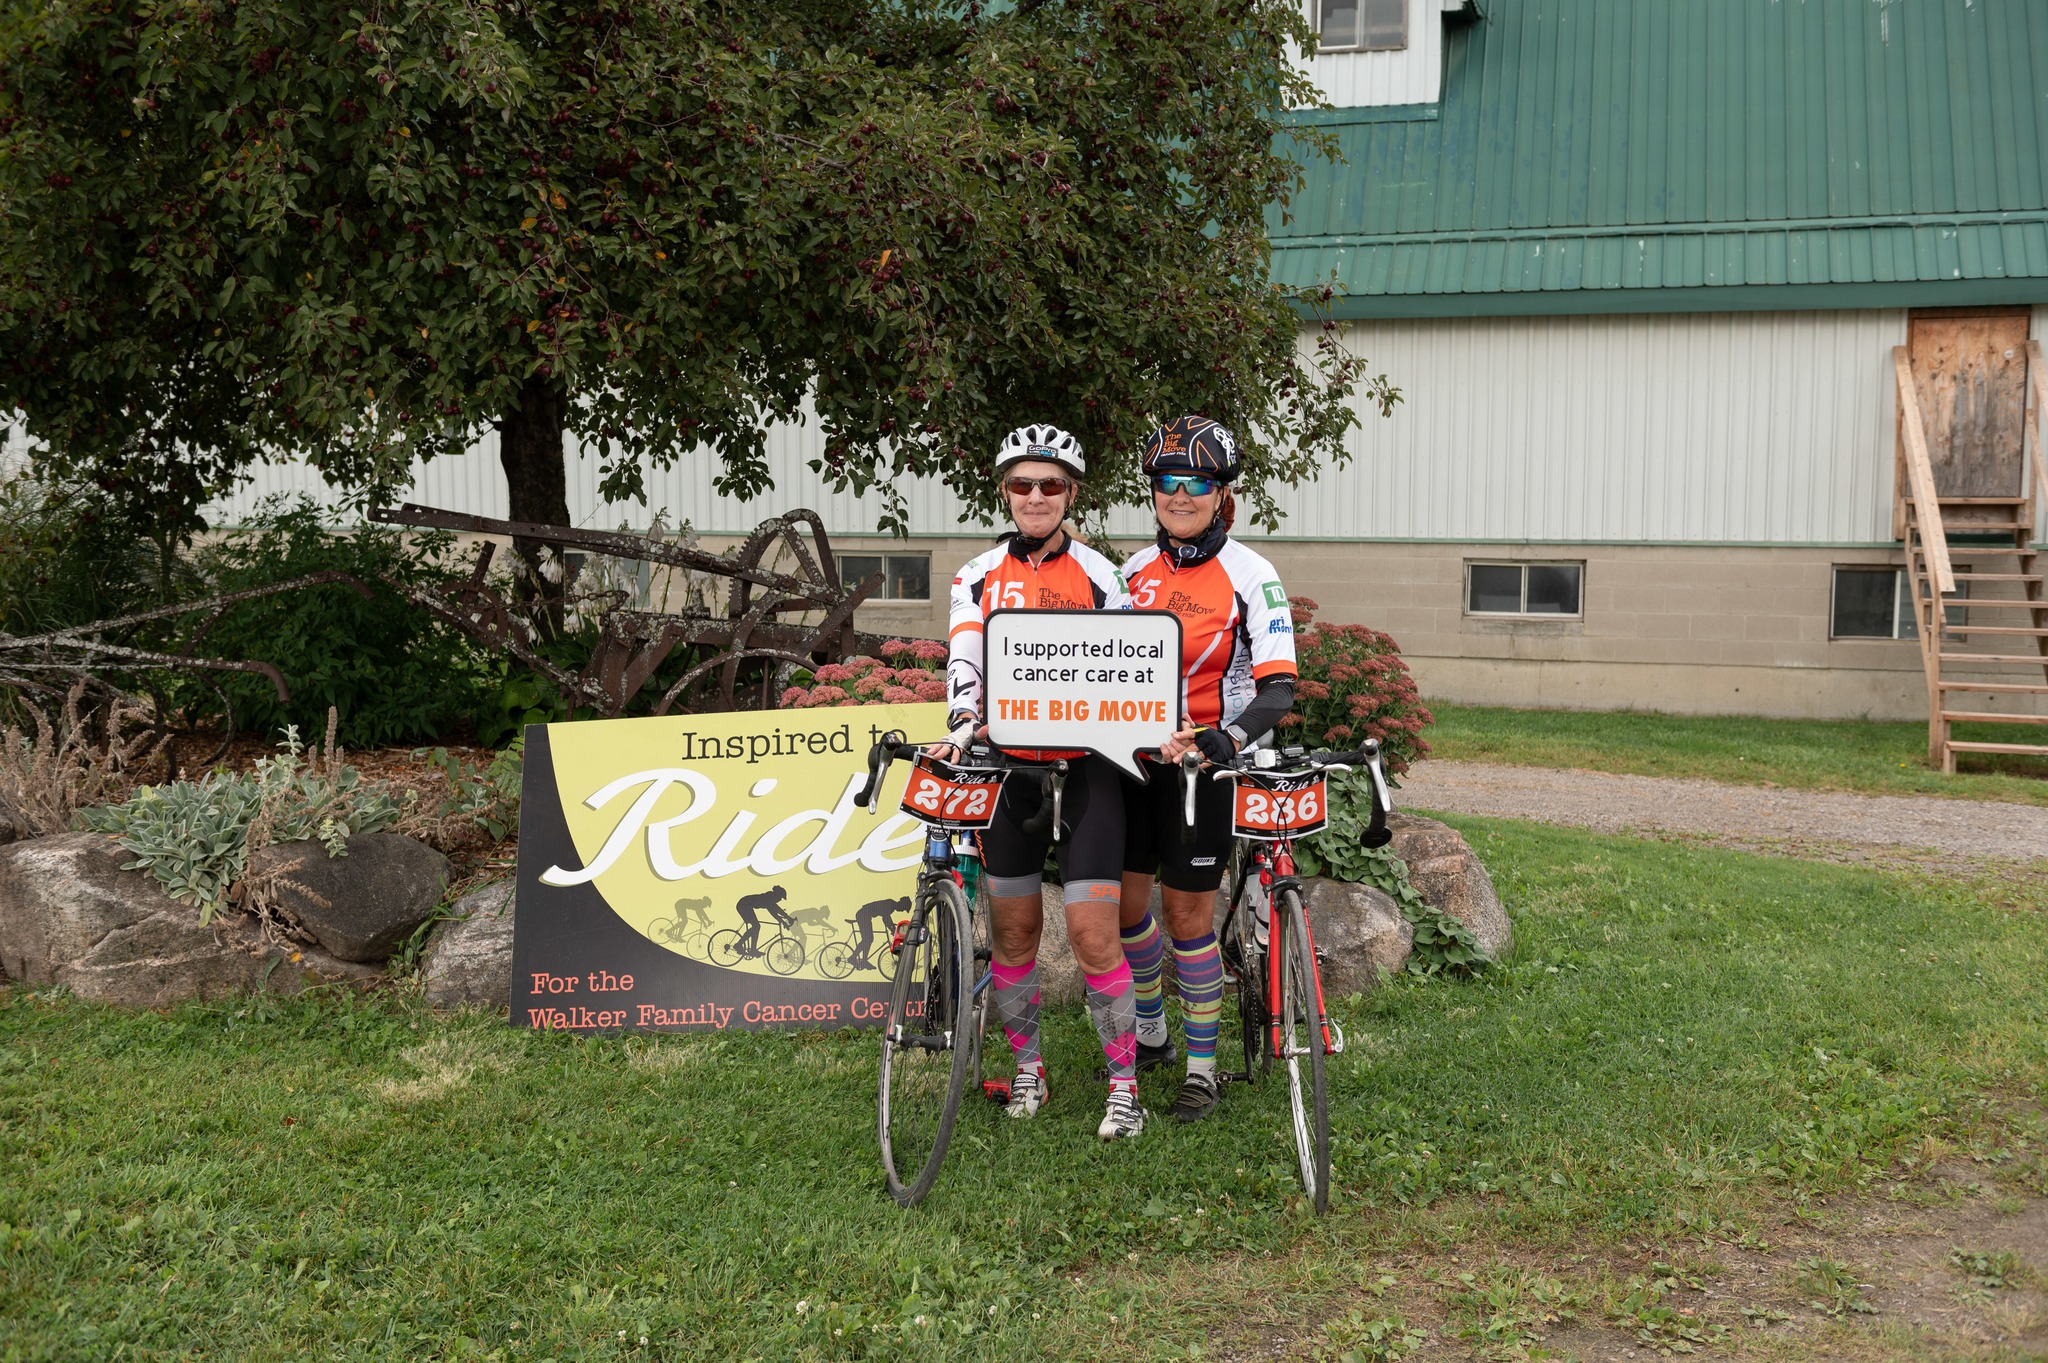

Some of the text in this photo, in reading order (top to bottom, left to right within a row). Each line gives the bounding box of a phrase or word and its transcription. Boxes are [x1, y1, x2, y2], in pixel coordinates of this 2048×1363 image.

[1028, 445, 1057, 454] GoPro
[986, 580, 1025, 609] 15
[1039, 587, 1061, 600] The
[1039, 597, 1058, 609] Big
[1165, 599, 1186, 612] Big
[1170, 591, 1191, 602] The
[1265, 586, 1286, 602] TD
[1004, 637, 1163, 661] I supported local
[1013, 667, 1154, 684] cancer care at
[998, 699, 1167, 723] THE BIG MOVE
[682, 724, 854, 764] Inspired
[949, 772, 986, 784] Ride
[914, 778, 989, 816] 272
[1244, 791, 1319, 825] 286
[541, 768, 927, 885] Ride
[530, 971, 634, 995] For the
[527, 1007, 627, 1030] Walker
[636, 1003, 734, 1029] Family
[743, 1000, 841, 1023] Cancer
